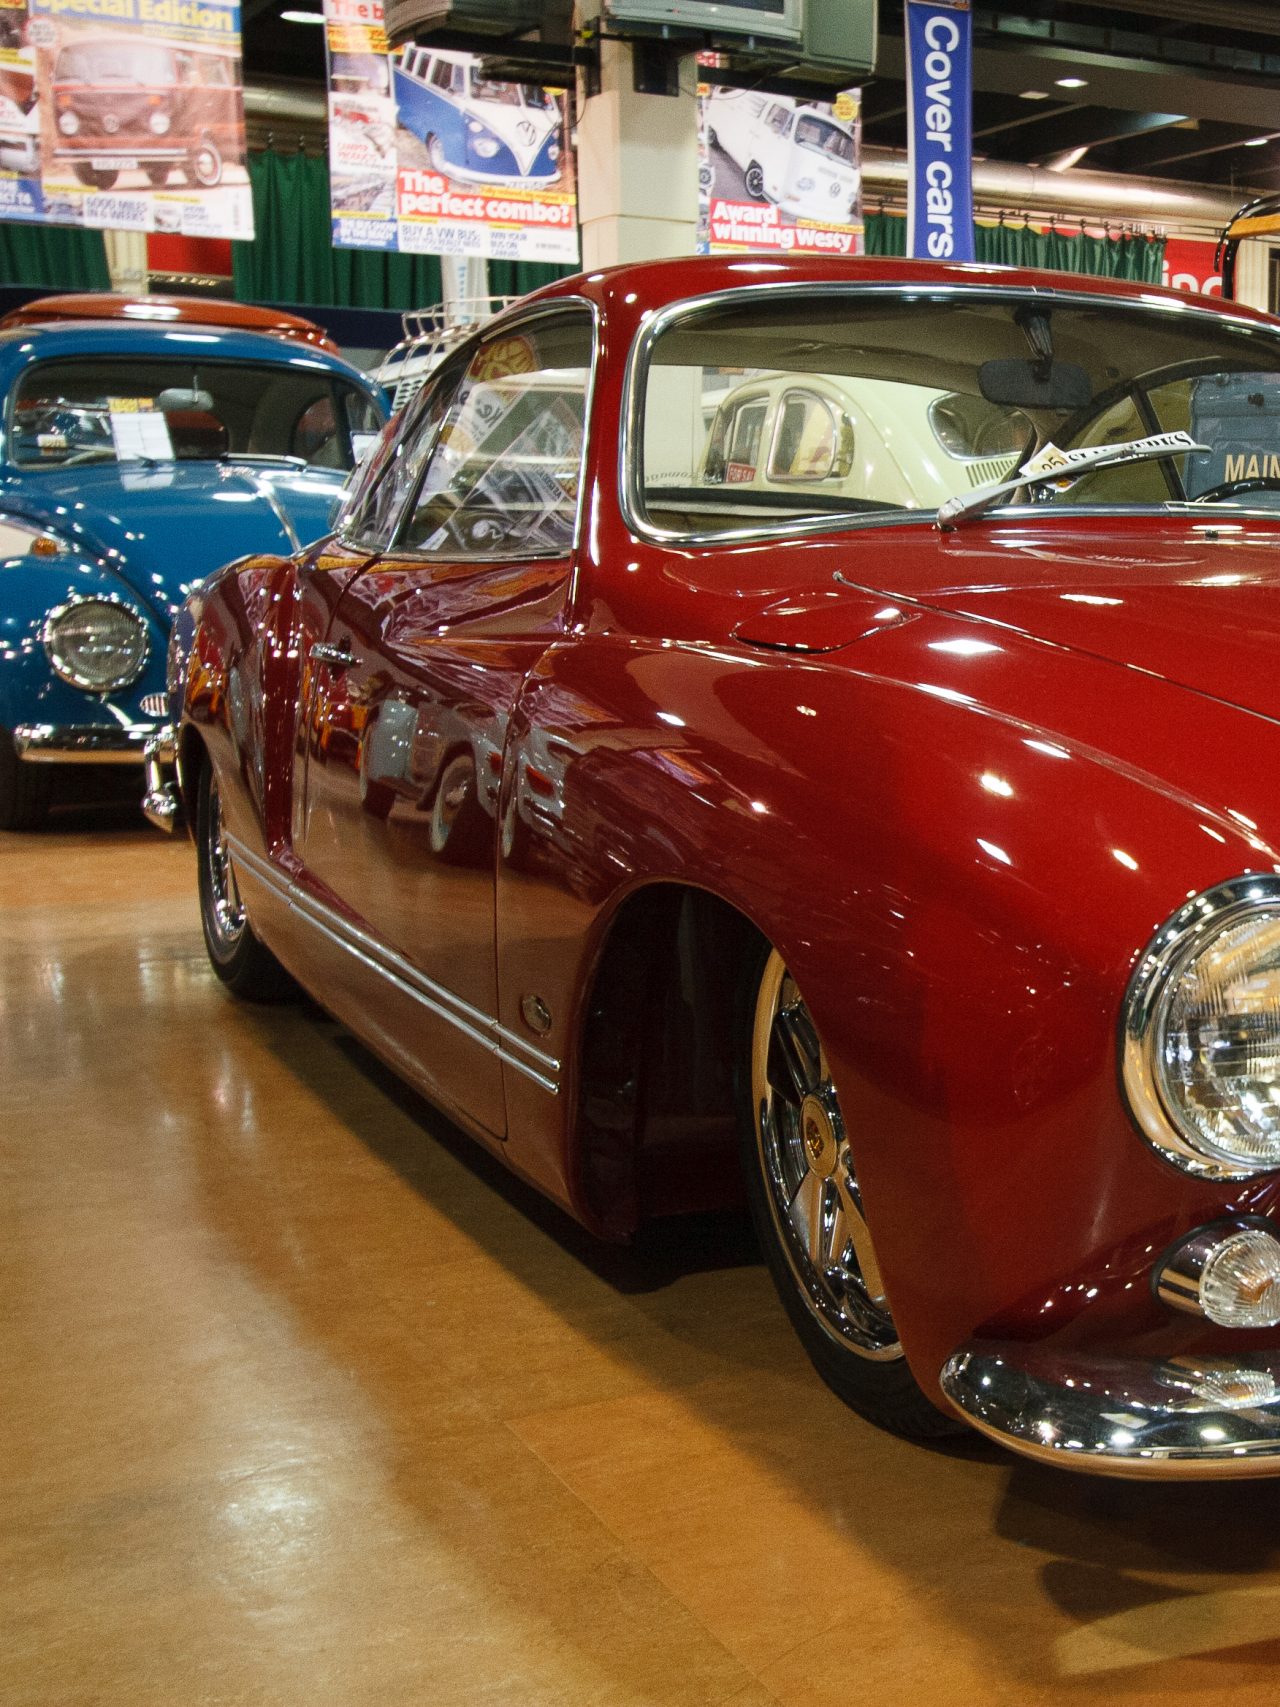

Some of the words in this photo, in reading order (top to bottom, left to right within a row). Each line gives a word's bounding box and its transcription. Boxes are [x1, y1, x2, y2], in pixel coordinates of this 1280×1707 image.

[140, 0, 233, 31] Edition
[924, 16, 960, 153] Cover
[400, 171, 445, 195] The
[401, 193, 485, 219] perfect
[485, 198, 570, 224] combo?
[712, 201, 776, 225] Award
[925, 160, 954, 258] cars
[713, 222, 797, 249] winning
[796, 228, 854, 253] Westy
